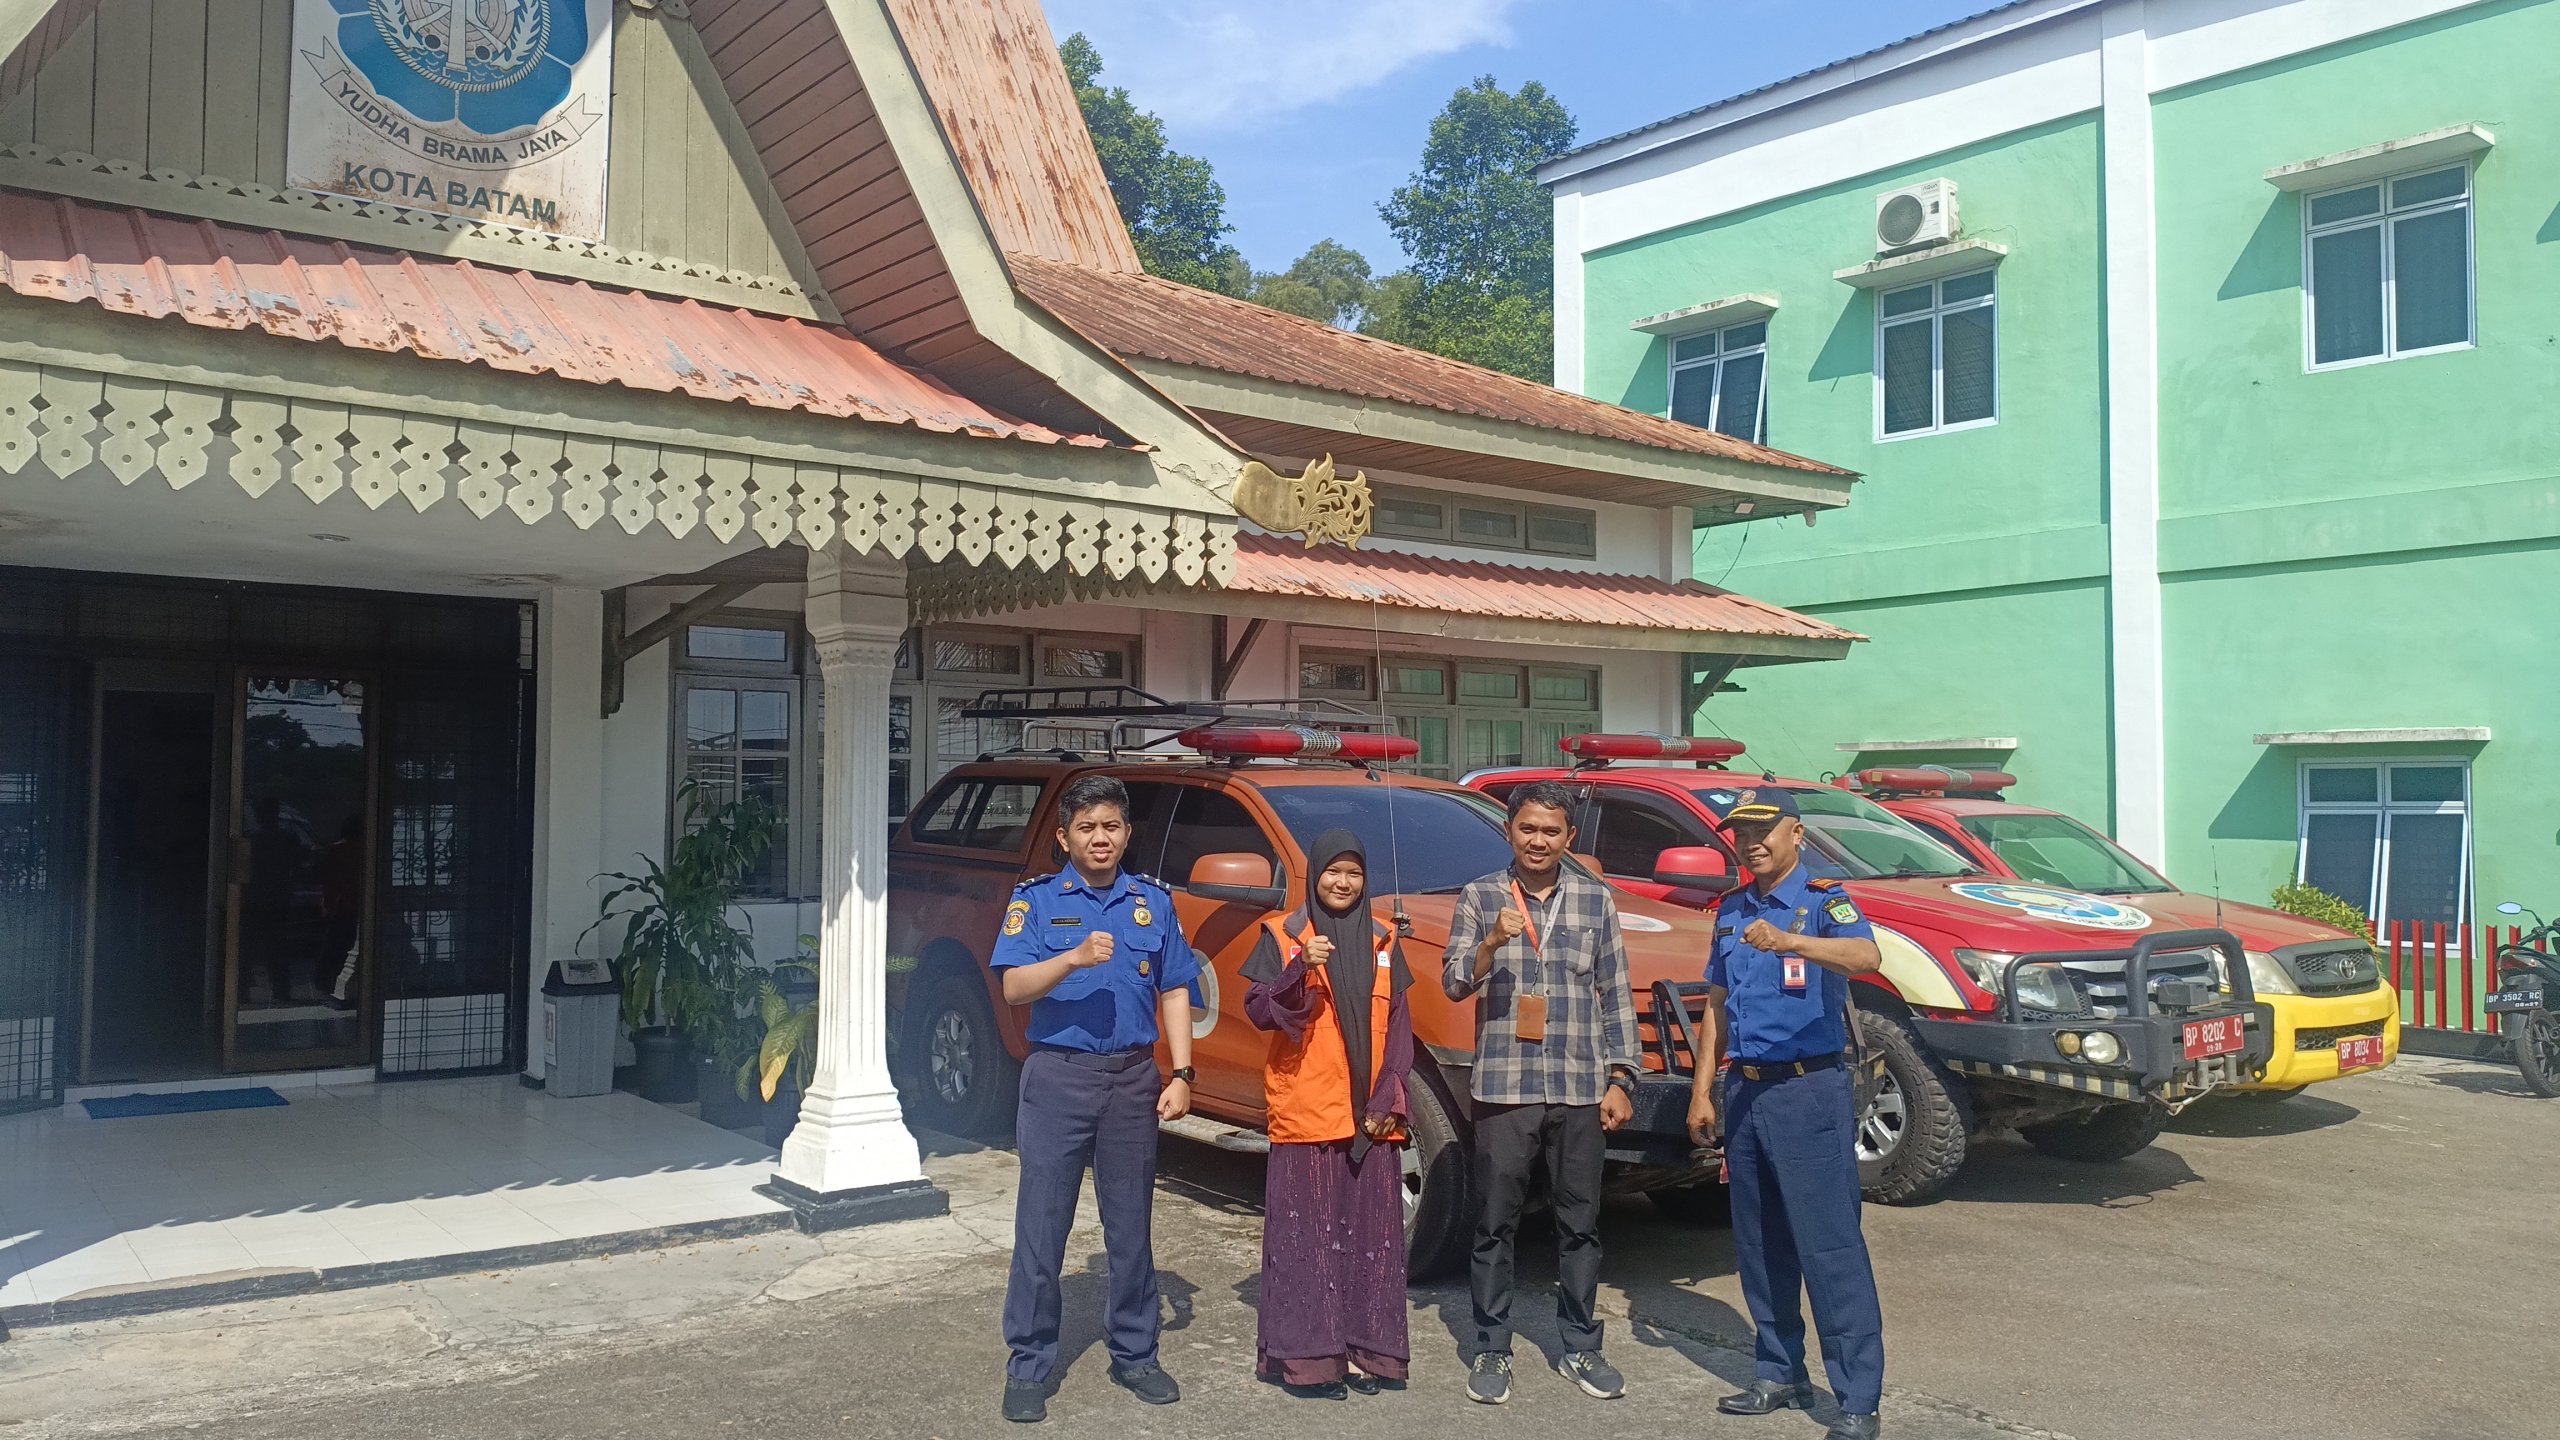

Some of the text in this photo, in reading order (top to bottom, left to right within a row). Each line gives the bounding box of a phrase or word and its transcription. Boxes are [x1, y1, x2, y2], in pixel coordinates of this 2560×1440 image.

[339, 81, 568, 164] YUDHA BRAMA JAYA
[343, 161, 557, 223] KOTA BATAM
[2489, 991, 2540, 1003] BP 3502 RC
[2185, 1017, 2241, 1047] BP 8202 C
[2341, 1042, 2351, 1059] BP
[2377, 1038, 2382, 1054] C
